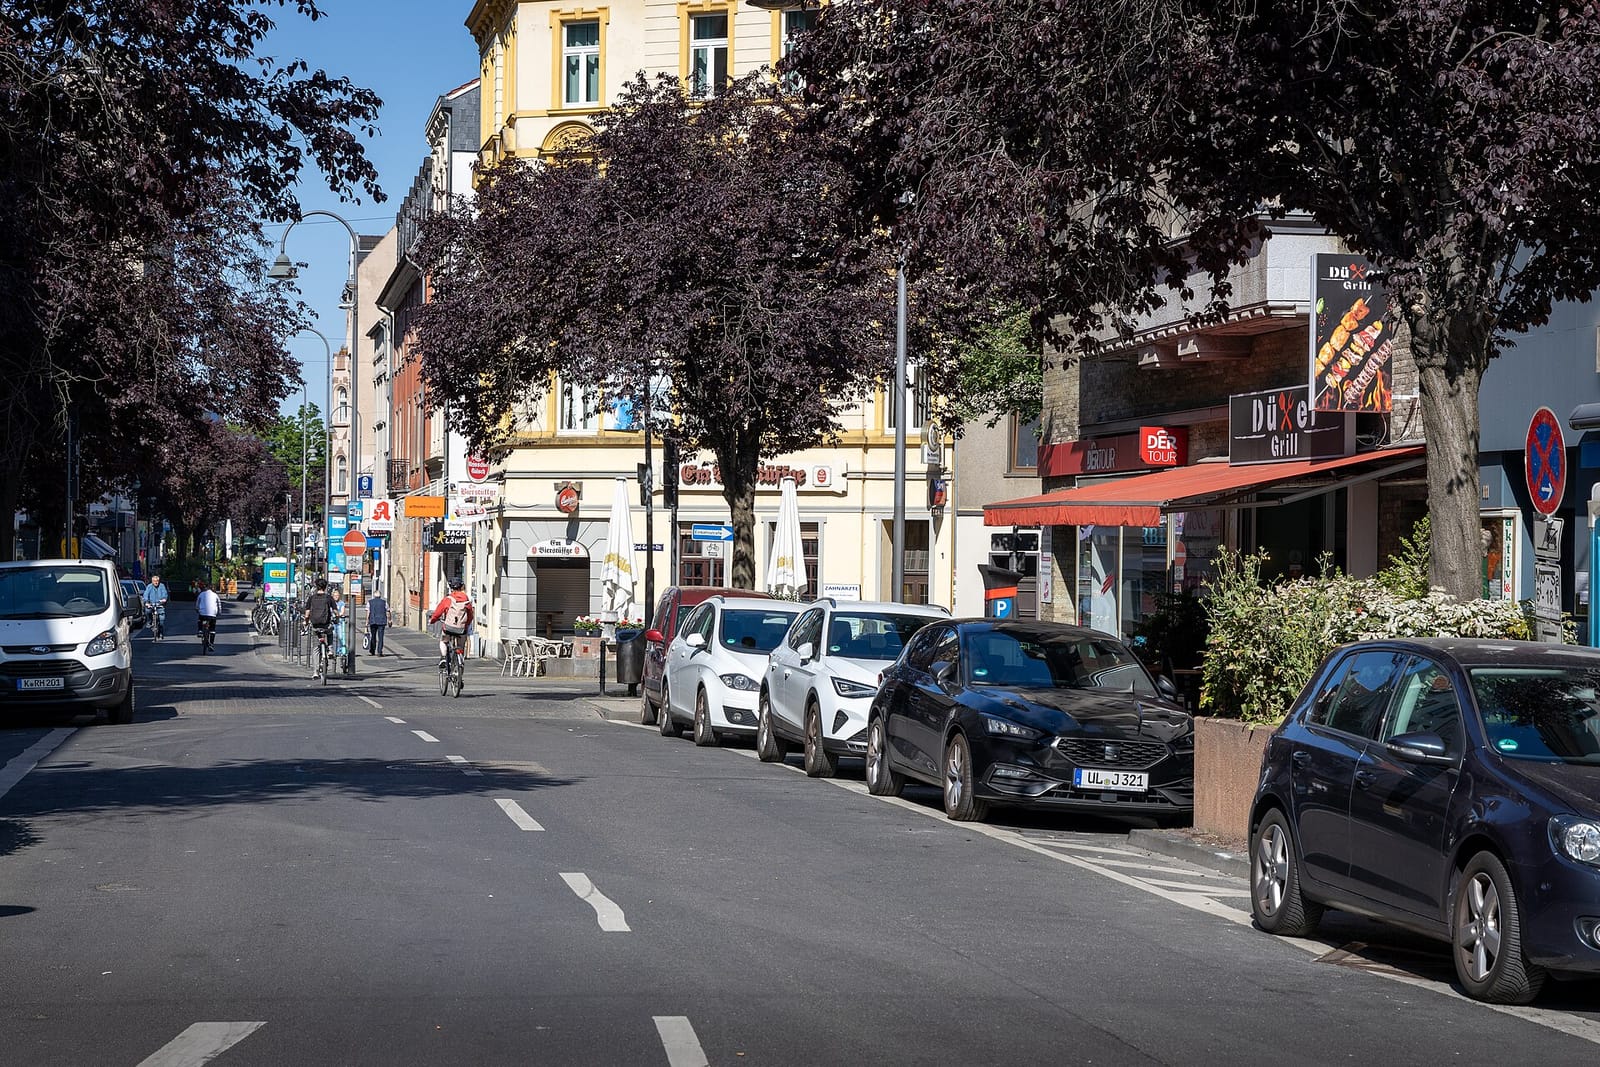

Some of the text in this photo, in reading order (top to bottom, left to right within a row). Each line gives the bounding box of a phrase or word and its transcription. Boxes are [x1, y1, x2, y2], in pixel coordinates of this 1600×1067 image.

[1343, 281, 1372, 290] Grill
[1271, 433, 1298, 457] Grill
[1148, 450, 1177, 462] TOUR
[681, 465, 711, 486] Em
[1088, 772, 1144, 787] UL J 321
